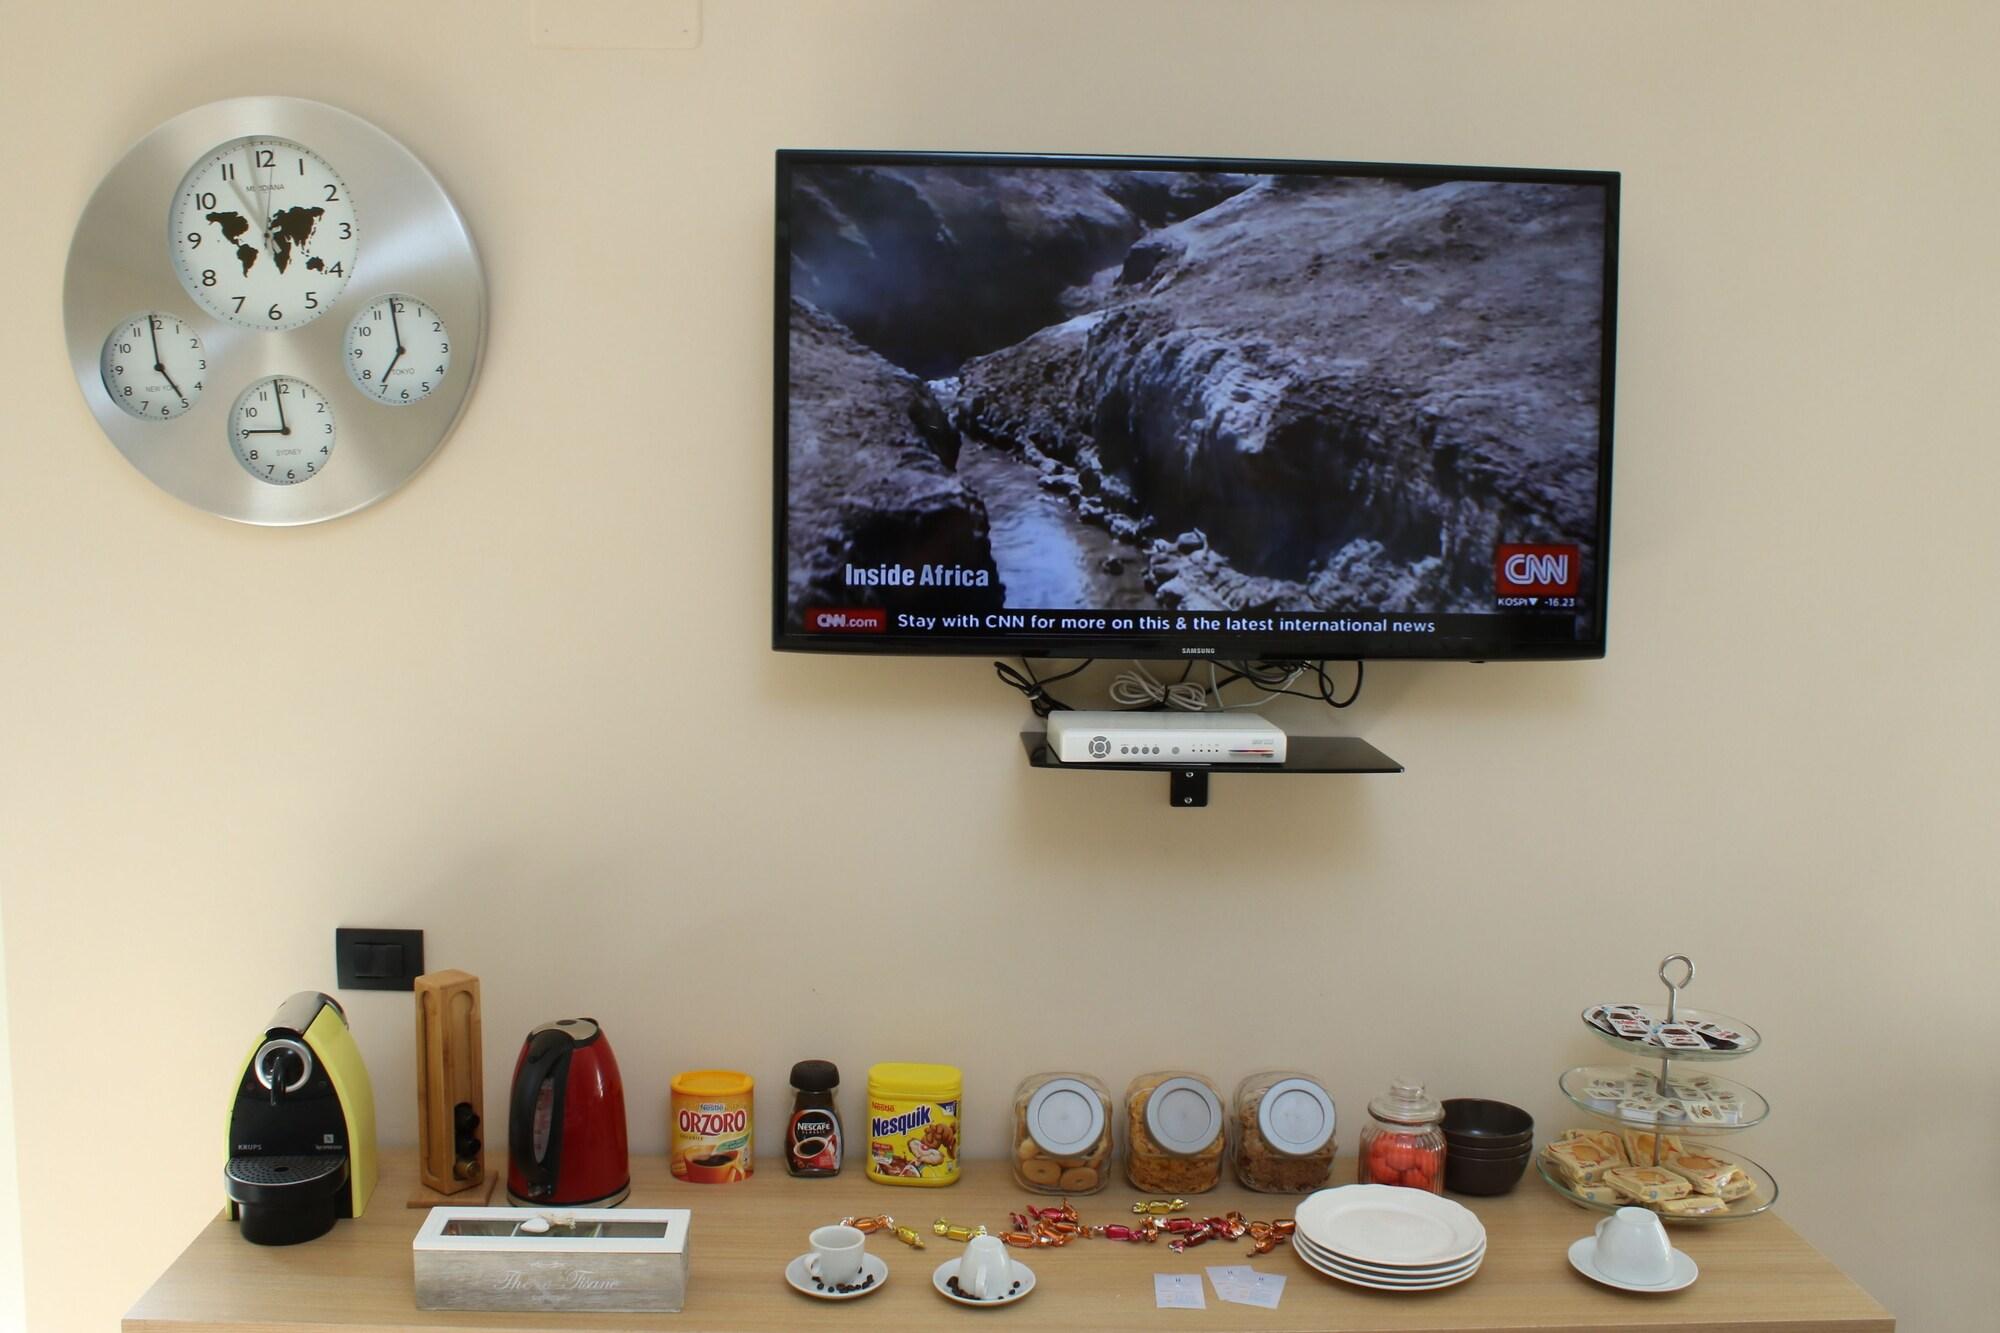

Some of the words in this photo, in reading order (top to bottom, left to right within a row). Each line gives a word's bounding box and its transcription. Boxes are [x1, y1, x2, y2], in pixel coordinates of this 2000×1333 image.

[255, 150, 276, 168] 12
[221, 163, 234, 181] 11
[323, 184, 340, 202] 2
[195, 192, 217, 210] 10
[339, 222, 352, 240] 3
[187, 232, 202, 249] 9
[328, 261, 344, 278] 4
[202, 269, 217, 286] 8
[231, 296, 246, 314] 7
[305, 291, 318, 309] 5
[268, 303, 282, 320] 6
[392, 303, 405, 313] 12
[374, 310, 382, 320] 11
[359, 326, 371, 337] 10
[432, 322, 441, 332] 2
[133, 328, 141, 338] 11
[119, 343, 132, 354] 10
[190, 338, 200, 349] 2
[440, 343, 449, 354] 3
[354, 348, 363, 359] 9
[115, 365, 124, 376] 9
[199, 360, 206, 370] 3
[435, 365, 444, 375] 4
[362, 369, 372, 380] 8
[123, 386, 133, 397] 8
[194, 381, 203, 391] 4
[278, 384, 290, 394] 12
[379, 384, 388, 394] 7
[421, 382, 430, 392] 5
[259, 391, 267, 402] 11
[400, 389, 410, 399] 6
[141, 400, 149, 411] 7
[181, 398, 190, 409] 5
[316, 402, 325, 413] 2
[161, 405, 170, 415] 6
[245, 407, 258, 418] 10
[241, 429, 250, 439] 9
[324, 424, 332, 434] 3
[250, 450, 258, 460] 8
[320, 446, 328, 455] 4
[266, 464, 275, 475] 7
[307, 462, 315, 472] 5
[287, 469, 295, 479] 6
[1504, 554, 1568, 584] CNN
[846, 563, 915, 586] Inside
[919, 564, 989, 587] Africa
[1497, 598, 1528, 606] KOSPI
[1544, 598, 1575, 606] -16.23
[816, 614, 878, 628] CNN.com
[898, 614, 936, 630] Stay
[942, 614, 979, 628] with
[985, 615, 1024, 628] CNN
[1031, 614, 1056, 629] for
[1061, 617, 1106, 630] more
[1112, 617, 1133, 630] on
[1139, 616, 1170, 630] this
[1175, 617, 1188, 630] &
[1193, 616, 1221, 630] the
[1226, 617, 1274, 631] latest
[1280, 618, 1387, 632] international
[1392, 620, 1436, 632] news
[680, 1110, 746, 1136] ORZORO
[872, 1106, 931, 1137] Nesquik
